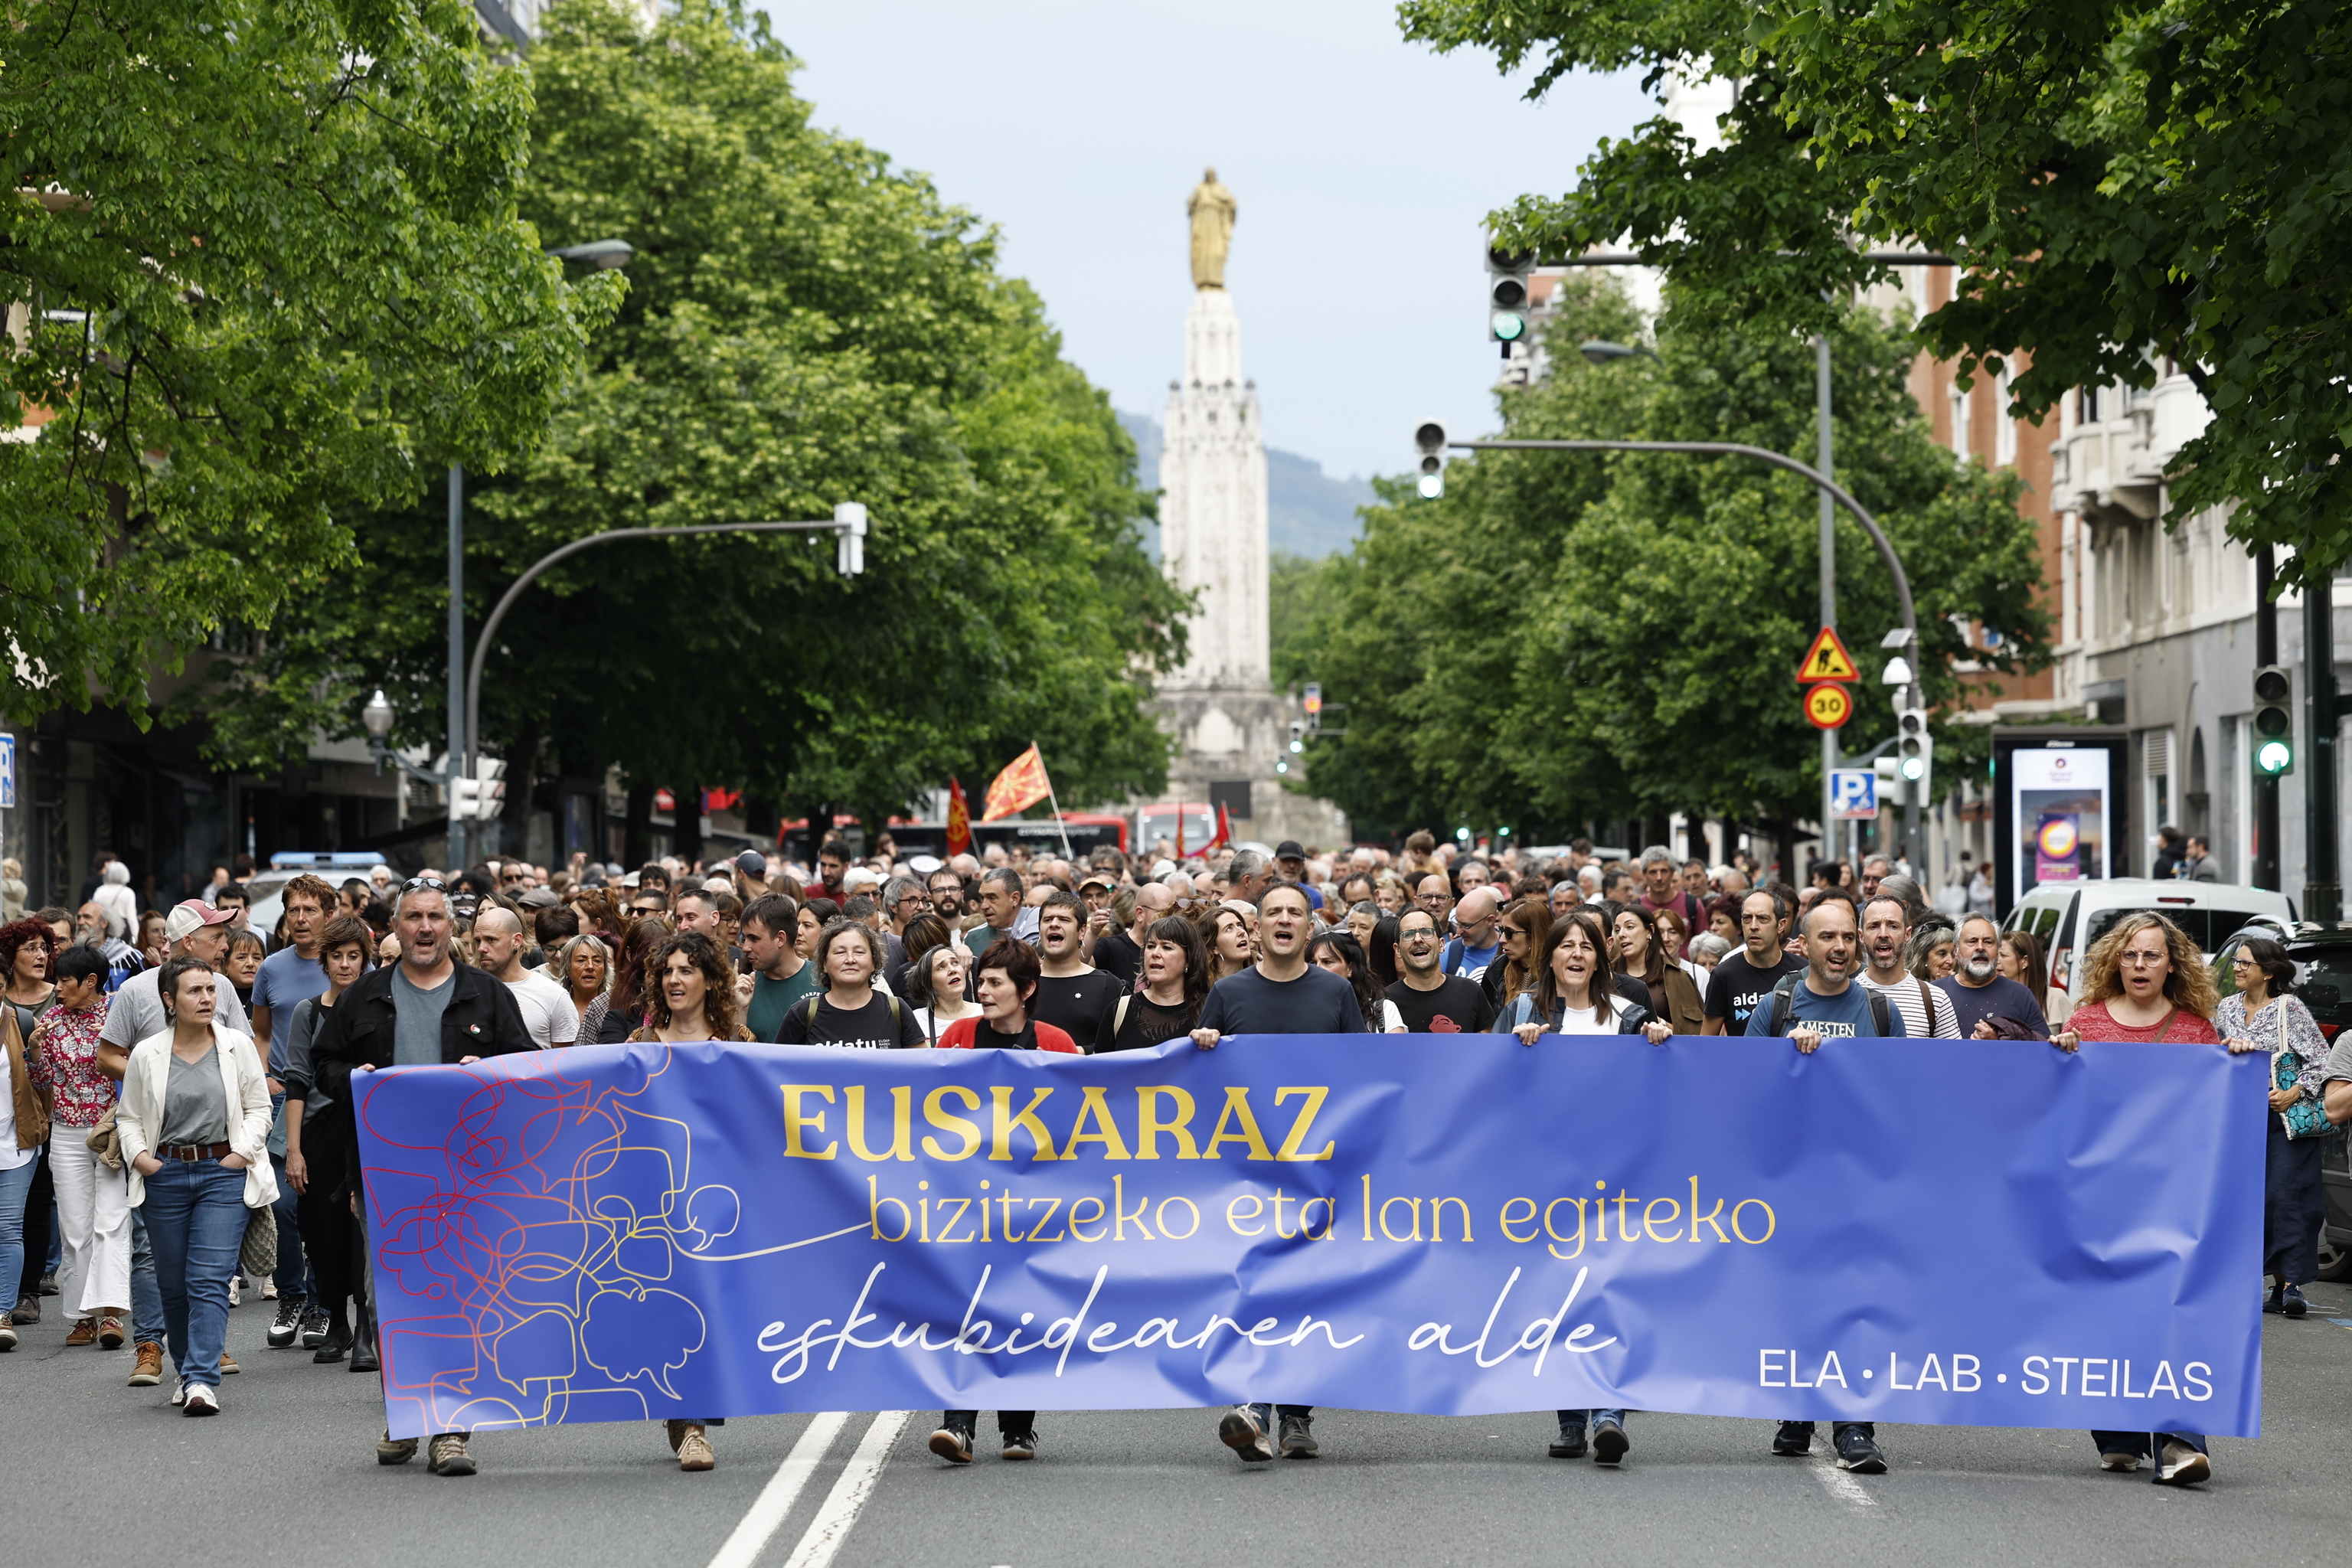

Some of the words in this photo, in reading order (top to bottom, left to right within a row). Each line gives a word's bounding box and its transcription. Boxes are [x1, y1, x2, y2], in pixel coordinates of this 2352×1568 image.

[1815, 698, 1841, 714] 30
[1838, 774, 1867, 802] P
[800, 991, 823, 1000] HARPE
[815, 1038, 877, 1049] datu
[780, 1084, 1335, 1162] EUSKARAZ
[867, 1174, 1200, 1243] bizitzeko
[1227, 1187, 1336, 1241] eta
[1361, 1174, 1474, 1242] lan
[1500, 1175, 1775, 1259] egiteko
[756, 1261, 1365, 1384] eskubidearen
[1408, 1266, 1617, 1377] alde
[1760, 1349, 1847, 1389] ELA
[1890, 1352, 1981, 1393] LAB
[2021, 1355, 2213, 1402] STEILAS
